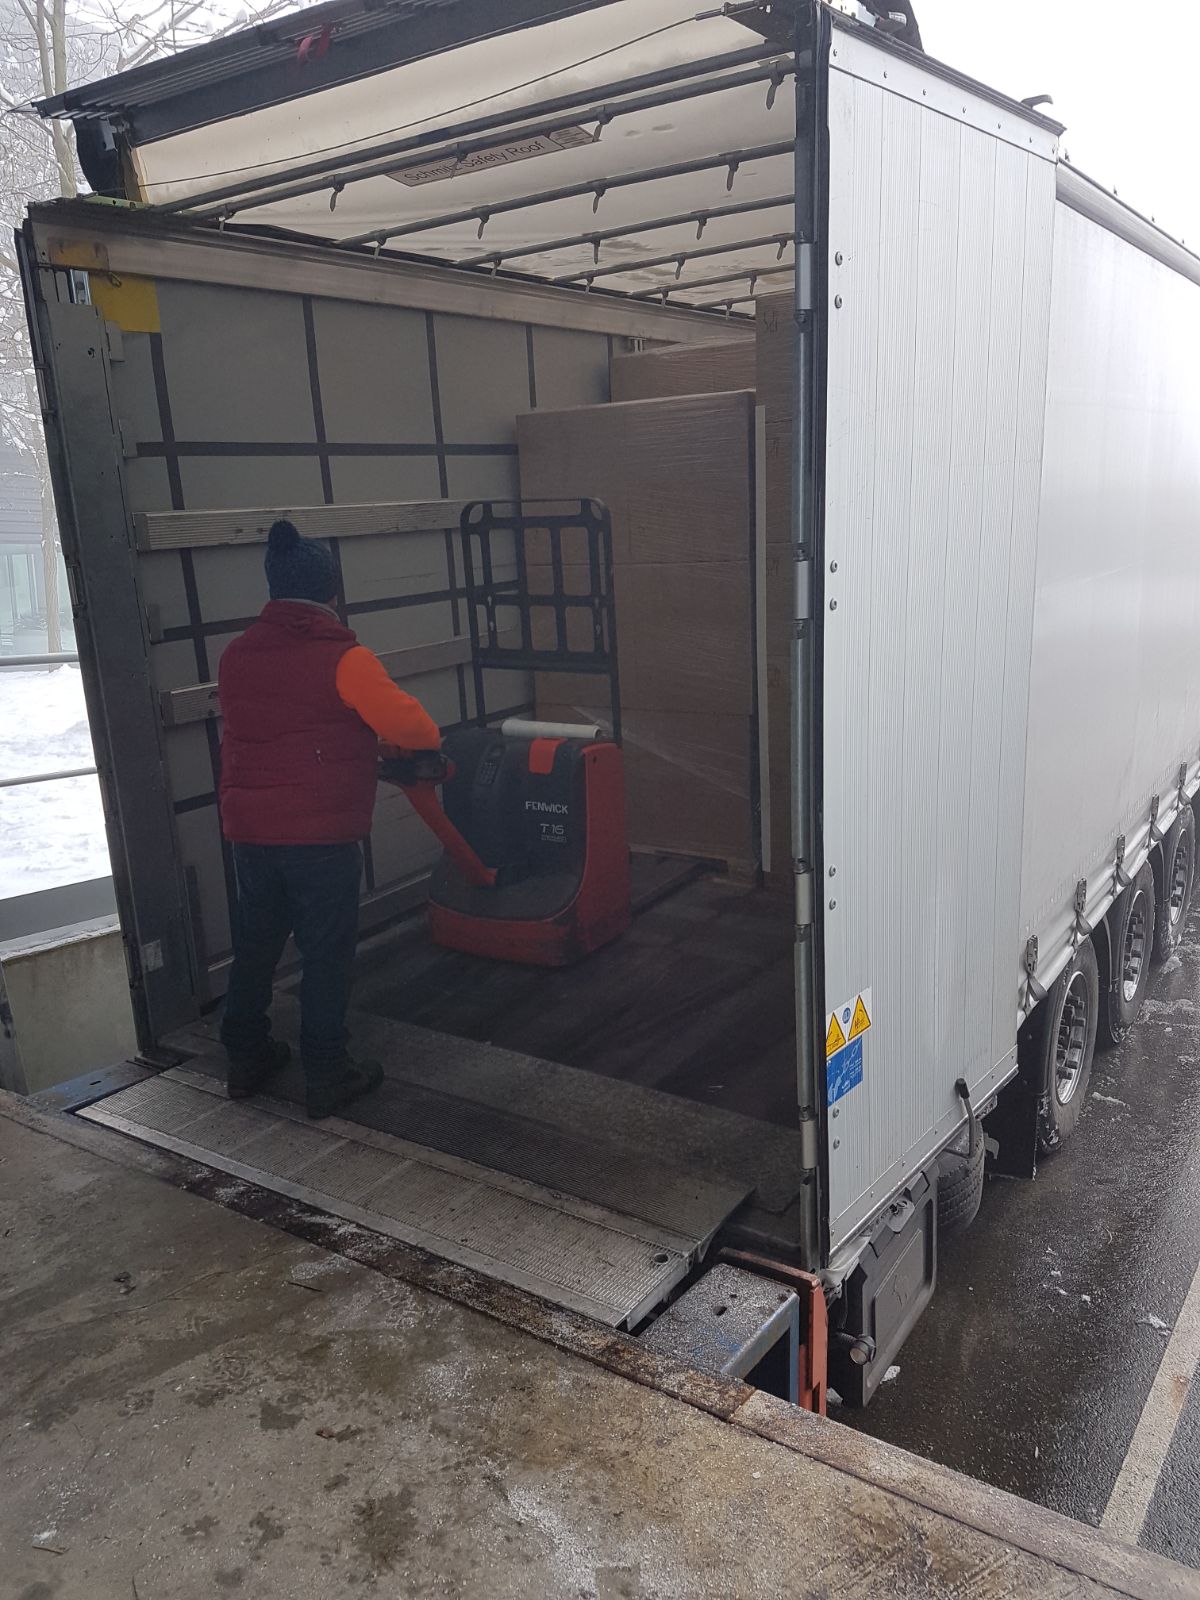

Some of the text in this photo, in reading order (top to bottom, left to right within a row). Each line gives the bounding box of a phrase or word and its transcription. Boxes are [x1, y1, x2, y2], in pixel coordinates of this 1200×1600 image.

[460, 150, 508, 168] Safety
[505, 140, 545, 157] Roof
[525, 801, 568, 814] FENWICK
